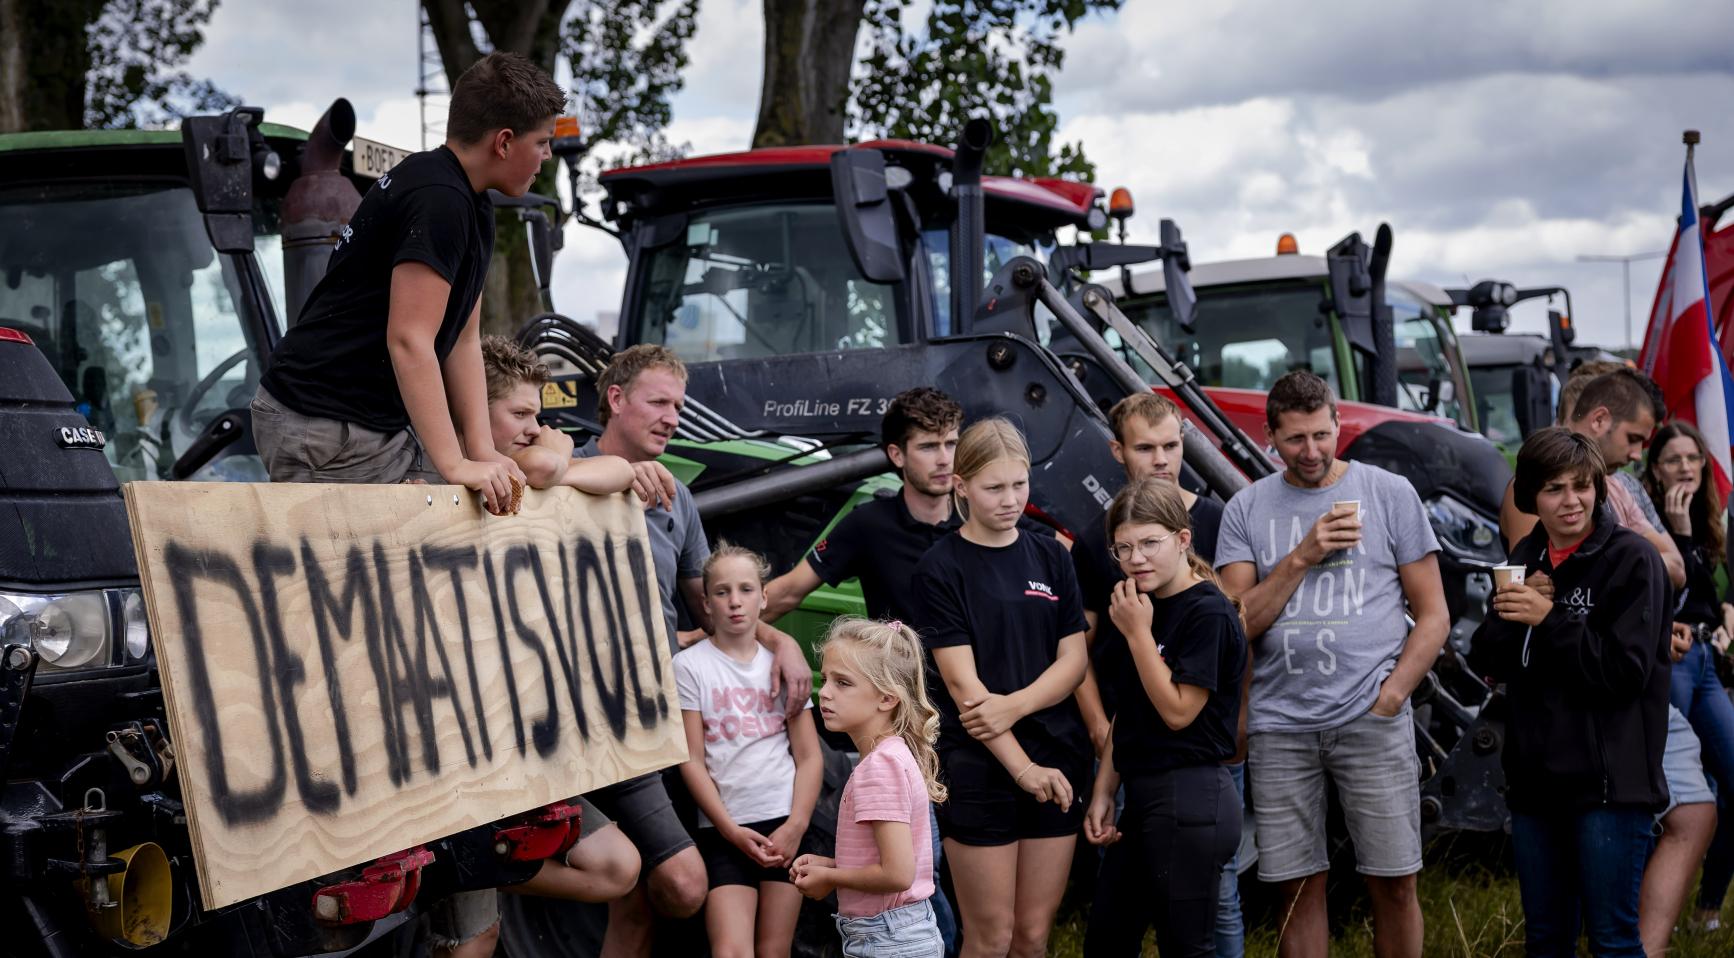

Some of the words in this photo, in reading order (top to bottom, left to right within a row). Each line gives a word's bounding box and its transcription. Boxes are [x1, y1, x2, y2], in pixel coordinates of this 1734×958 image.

[763, 400, 840, 416] ProfiLine
[846, 398, 872, 415] FZ
[61, 427, 97, 445] CASE
[1285, 568, 1366, 617] JON
